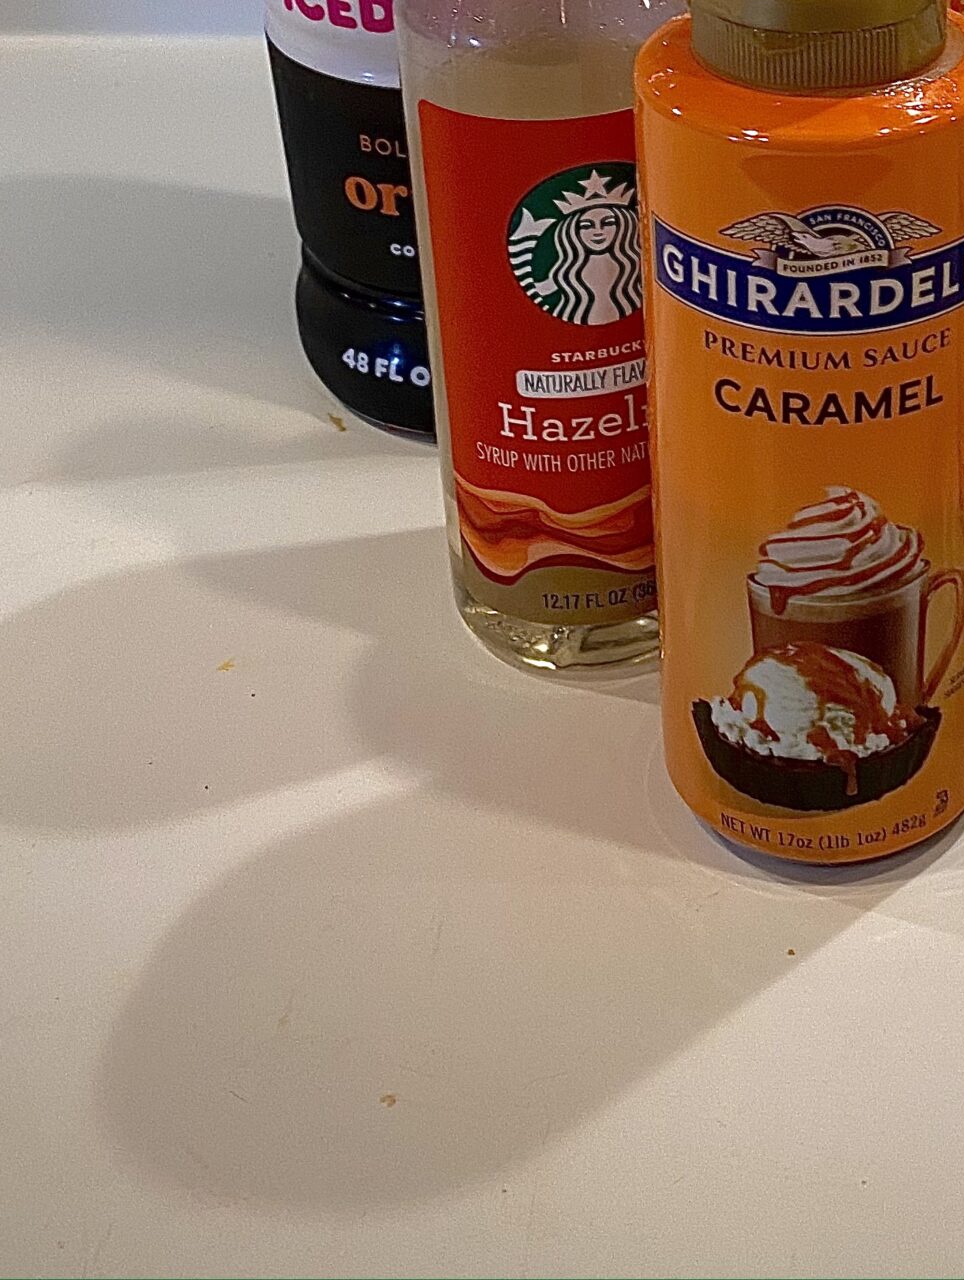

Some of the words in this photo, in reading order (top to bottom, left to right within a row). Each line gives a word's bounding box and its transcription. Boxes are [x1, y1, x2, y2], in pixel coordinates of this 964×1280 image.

[359, 134, 408, 159] BOL
[344, 176, 413, 217] or
[809, 213, 832, 225] SAN
[836, 212, 886, 247] FRANCISCO
[783, 261, 839, 273] FOUNDED
[842, 258, 855, 267] IN
[859, 253, 883, 265] 1852
[342, 349, 369, 374] 48
[375, 357, 403, 382] FL
[551, 339, 646, 363] STARBUCK
[704, 330, 852, 370] PREMIUM
[864, 328, 952, 367] SAUCE
[524, 369, 608, 394] NATURALLY
[714, 375, 944, 426] CARAMEL
[498, 394, 648, 442] Hazel
[476, 441, 519, 468] SYRUP
[523, 453, 562, 473] WITH
[567, 449, 616, 472] OTHER
[543, 593, 580, 610] 12.17
[585, 592, 604, 608] FL
[608, 590, 628, 606] OZ
[720, 812, 747, 834] NET
[750, 823, 772, 842] WT
[777, 832, 813, 849] 17oz
